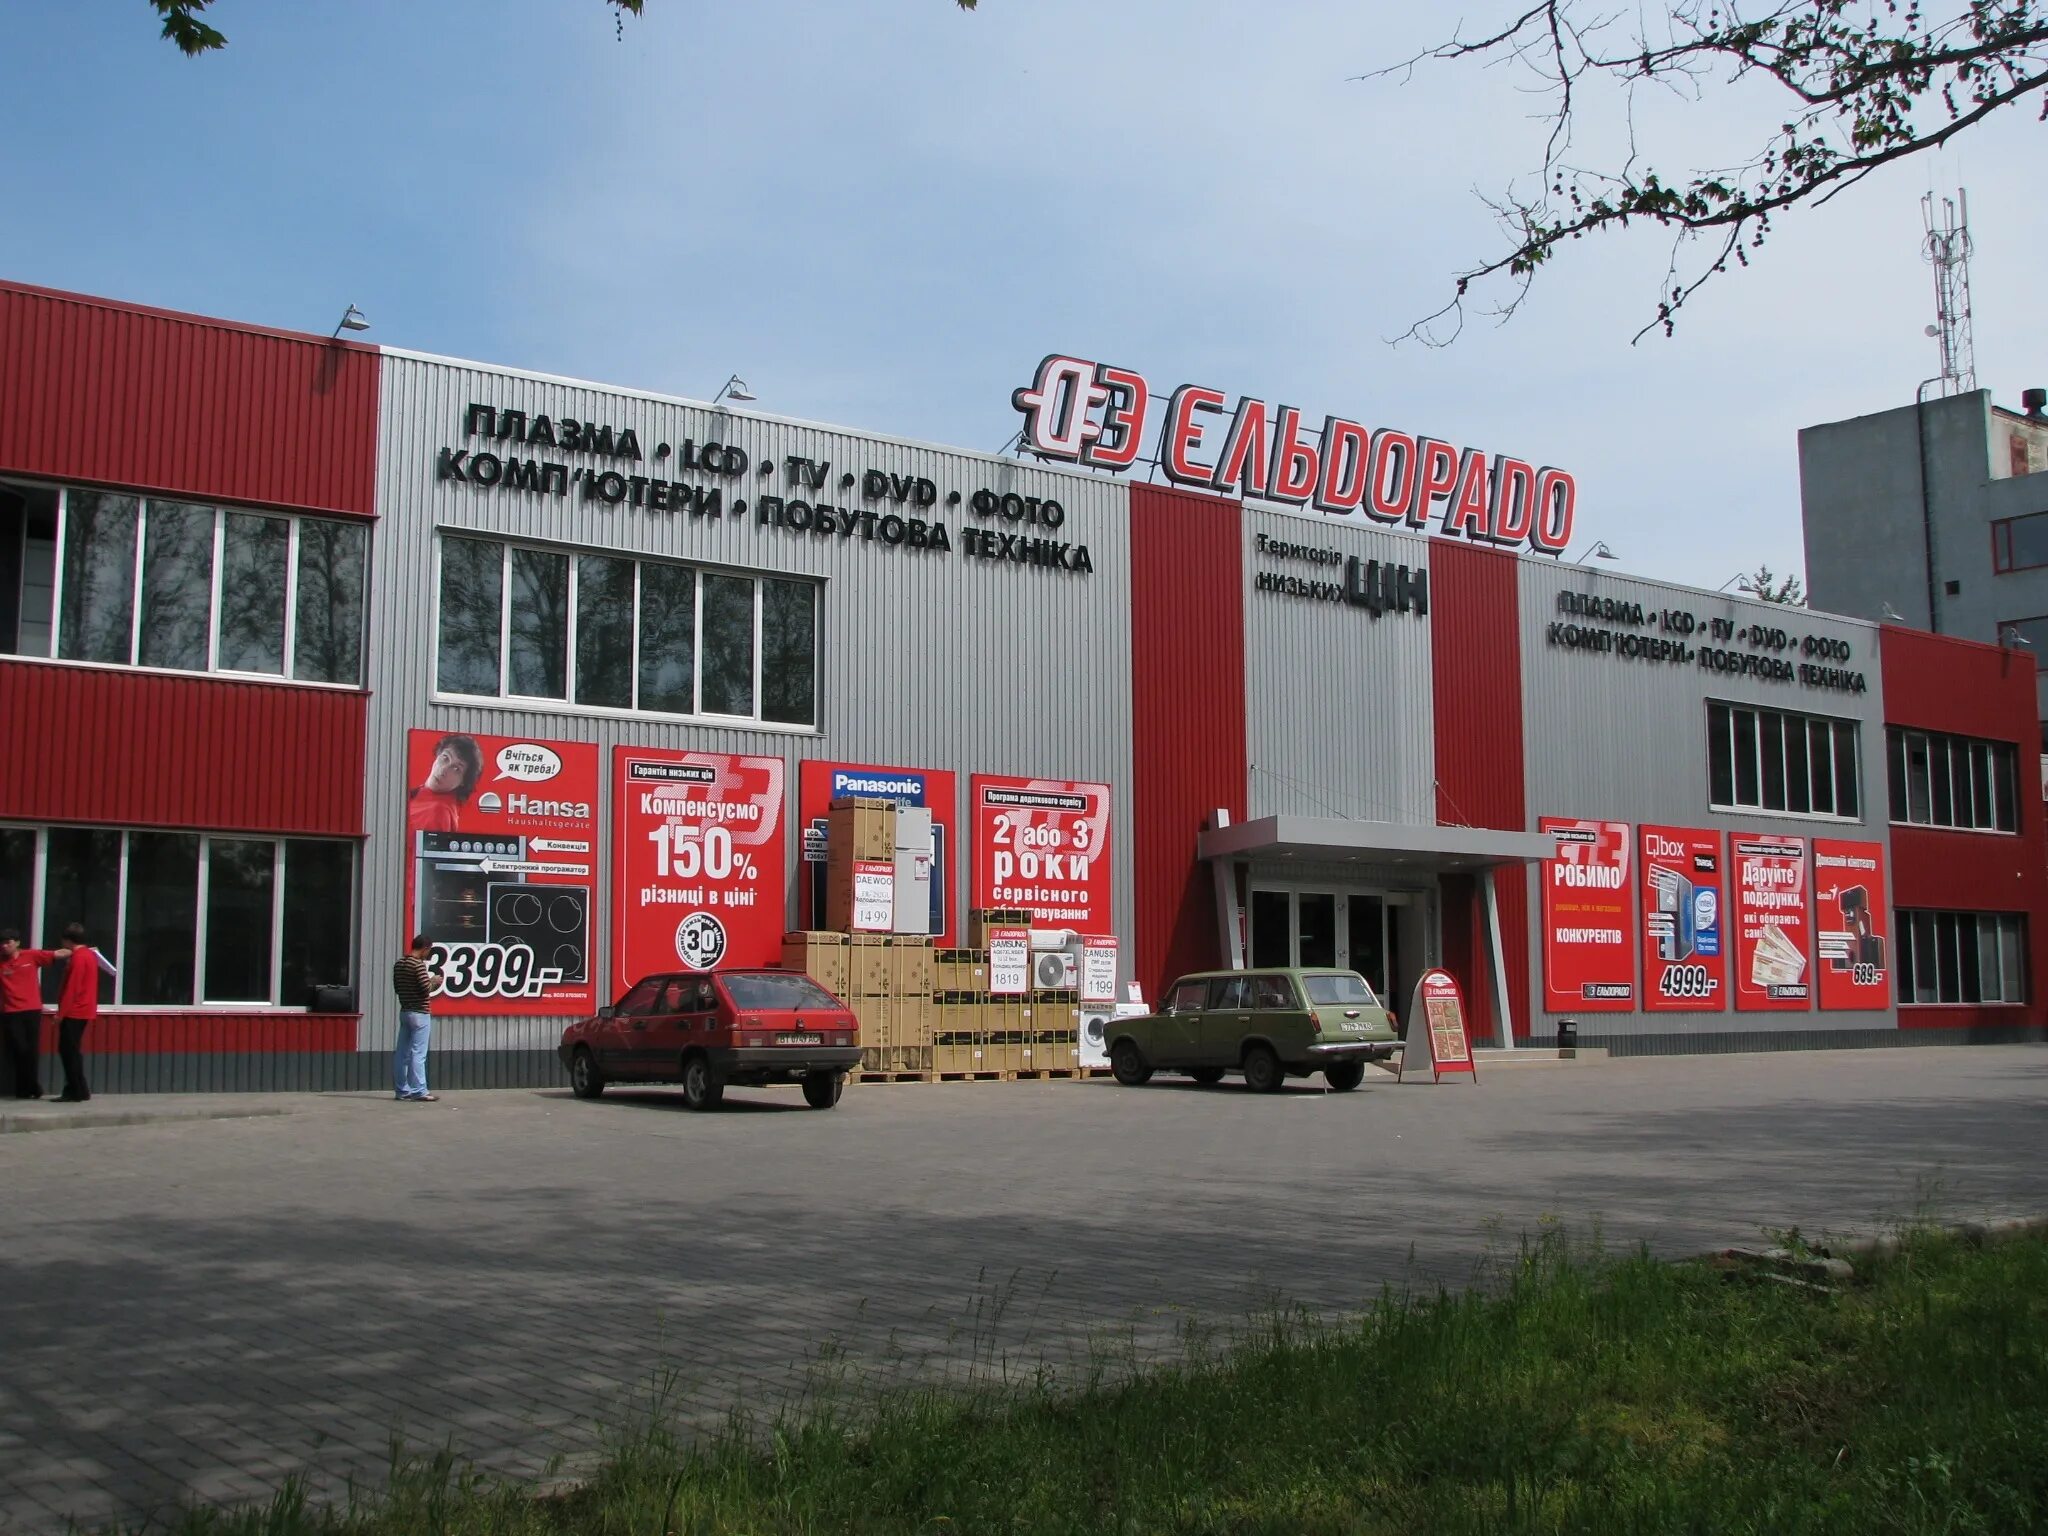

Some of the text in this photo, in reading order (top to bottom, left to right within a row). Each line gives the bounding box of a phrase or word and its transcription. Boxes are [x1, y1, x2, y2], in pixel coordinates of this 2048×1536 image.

[467, 402, 1065, 529] ПЛАЗМА LCD TV DVD ФОТО
[760, 495, 951, 552] ПОБУТОВА
[962, 527, 1094, 574] ТЕХНІКА
[1256, 533, 1343, 566] Територія
[1256, 555, 1428, 619] низьких ЦІН
[1558, 590, 1850, 661] ПЛАЗМА LCD TV DVD ФОТО
[1699, 646, 1795, 682] ПОБУТОВА
[1799, 663, 1868, 693] ТЕХНІКА
[505, 750, 543, 762] Вчіться
[524, 764, 555, 774] треба!
[634, 765, 713, 780] Гарантія низьких цін
[835, 774, 921, 794] Panasonic
[507, 793, 590, 819] Hansa
[641, 792, 758, 823] Компенсуємо
[988, 791, 1082, 808] Програма додаткового сервісу
[993, 814, 1089, 849] 2 або 3
[547, 841, 586, 851] Конвекція
[648, 825, 757, 880] 150%
[541, 865, 586, 874] програматор
[994, 850, 1089, 886] роки
[1554, 863, 1620, 889] РОБИМО
[1743, 861, 1795, 887] Даруйте
[856, 875, 893, 886] DAEWOO
[641, 884, 703, 907] різниці
[709, 890, 718, 904] в
[993, 885, 1089, 904] сервісного
[1743, 890, 1804, 910] подарунки,
[1744, 912, 1800, 927] які обирають
[686, 929, 715, 951] 30
[991, 940, 1027, 949] SAMSUNG
[1556, 927, 1622, 944] КОНКУРЕНТІВ
[1084, 949, 1115, 958] ZANUSSI
[995, 973, 1019, 985] 1819
[1089, 980, 1113, 993] 1199
